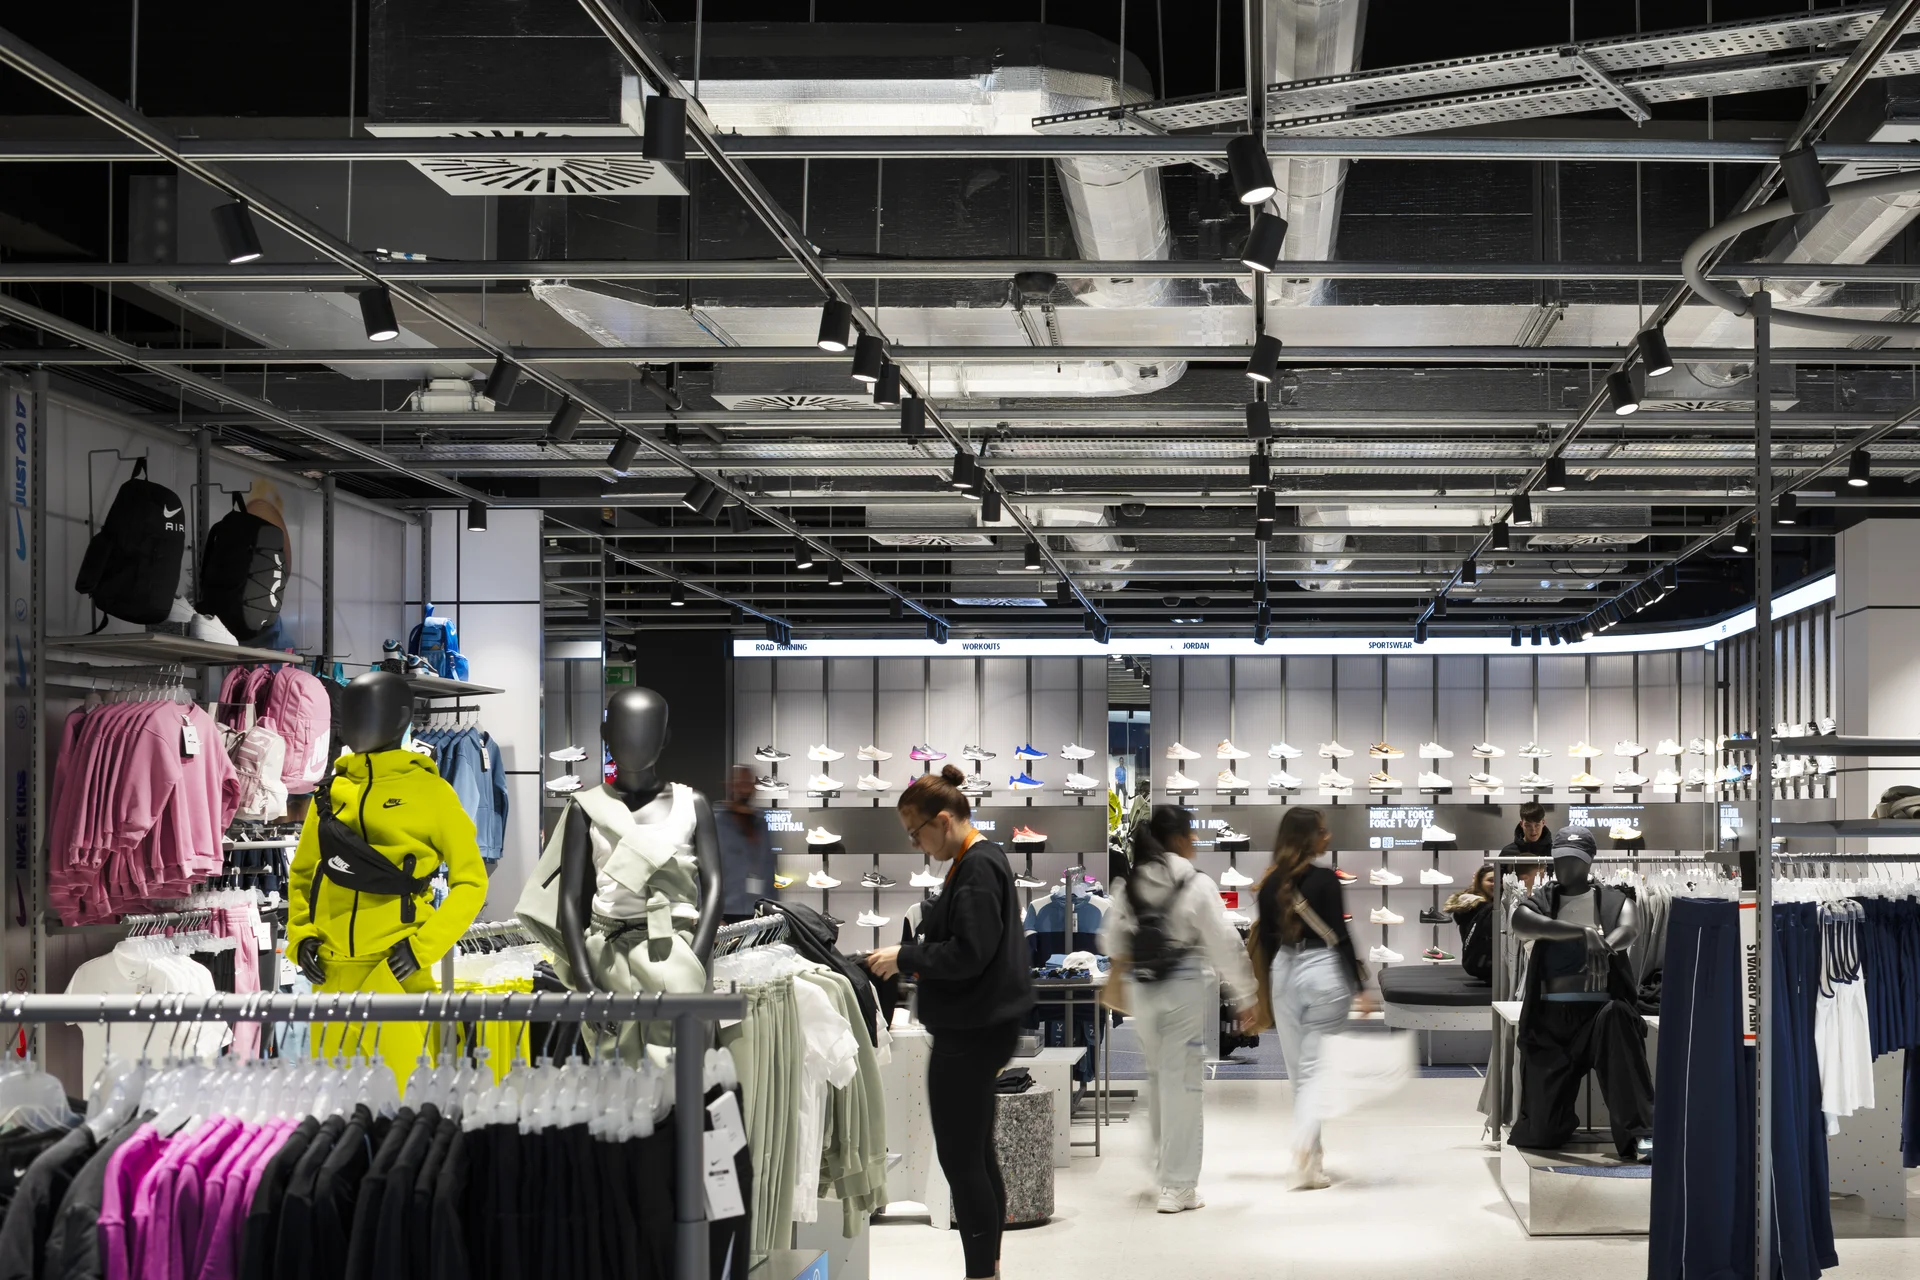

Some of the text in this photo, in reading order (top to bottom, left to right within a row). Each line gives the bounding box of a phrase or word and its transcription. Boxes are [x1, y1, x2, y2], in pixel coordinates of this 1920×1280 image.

[16, 422, 27, 455] DO
[16, 456, 27, 507] JUST
[165, 522, 185, 533] AIR
[755, 643, 808, 651] ROAD RUNNING
[962, 642, 1001, 650] WORKOUTS
[1182, 642, 1210, 650] JORDAN
[1368, 641, 1413, 649] SPORTSWEAR
[16, 769, 27, 817] KIDS
[763, 813, 792, 823] RINGY
[1369, 809, 1434, 819] NIKE AIR FORCE
[1568, 809, 1589, 819] NIKE
[767, 821, 805, 832] NEUTRAL
[970, 820, 996, 831] XIBLE
[1369, 818, 1396, 829] FORCE
[1568, 818, 1596, 827] ZOOM
[1747, 944, 1757, 999] ARRIVALS
